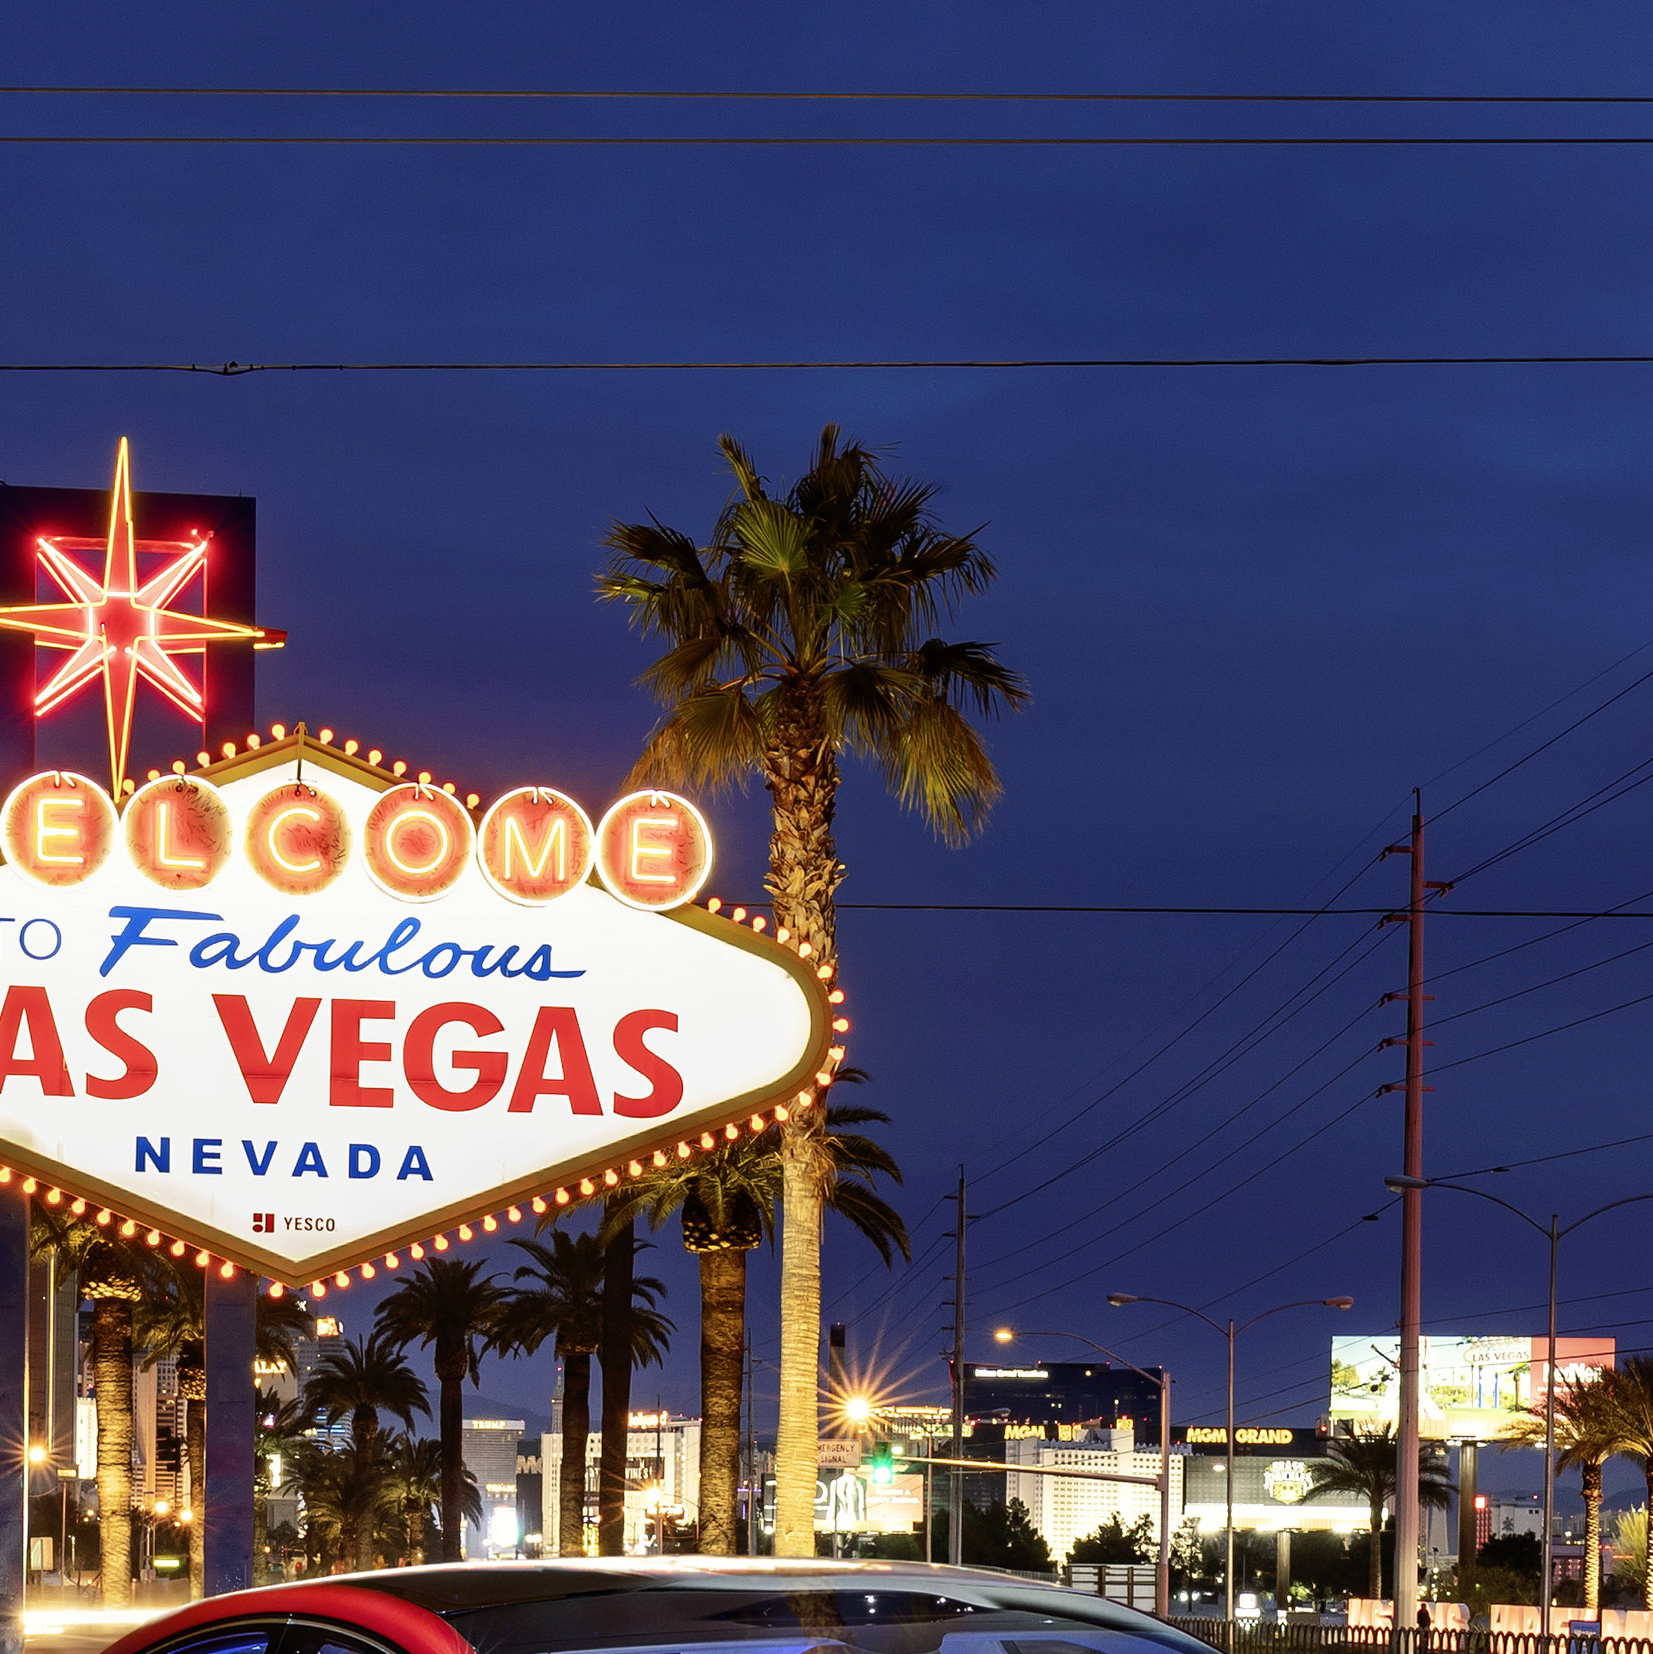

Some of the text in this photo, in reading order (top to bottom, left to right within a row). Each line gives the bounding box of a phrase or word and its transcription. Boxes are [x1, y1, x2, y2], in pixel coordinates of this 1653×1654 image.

[98, 905, 586, 981] Fabulous
[210, 992, 684, 1118] VEGAS
[134, 1136, 434, 1182] NEVADA
[283, 1216, 336, 1232] YESCO
[1472, 1351, 1530, 1362] LAS VEGAS
[1004, 1424, 1046, 1440] MGM
[1186, 1427, 1293, 1444] MGM GRAND
[817, 1443, 856, 1453] MERGENCY
[820, 1455, 847, 1464] SIGNAL
